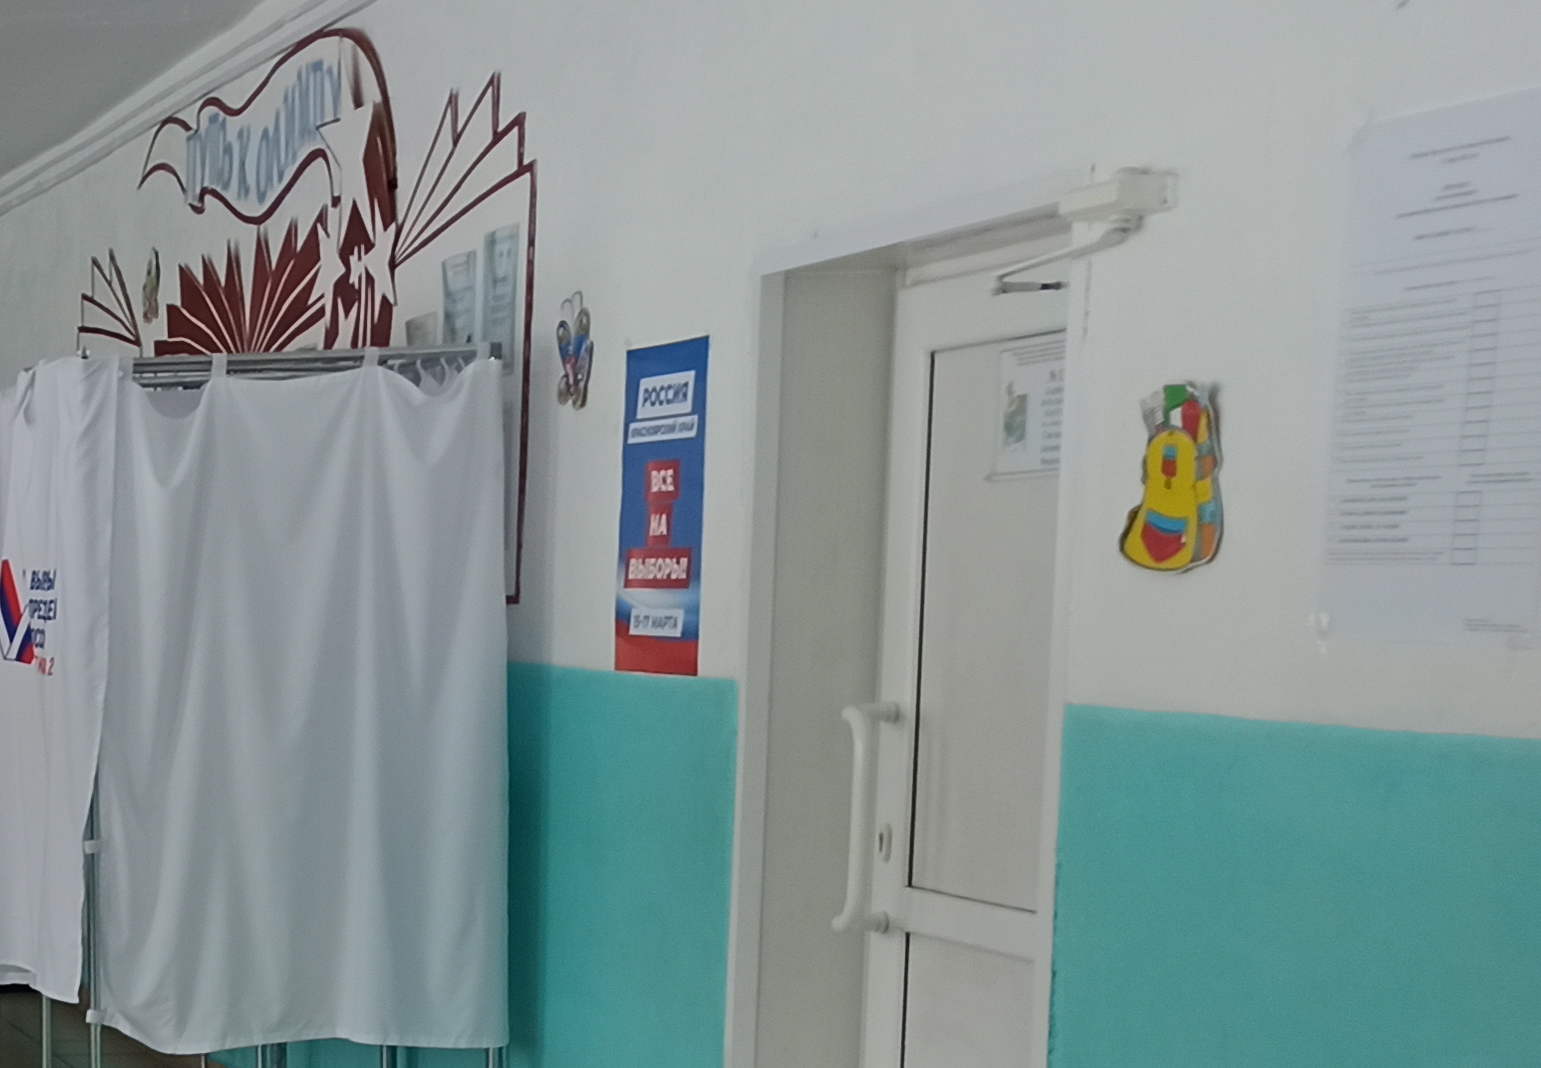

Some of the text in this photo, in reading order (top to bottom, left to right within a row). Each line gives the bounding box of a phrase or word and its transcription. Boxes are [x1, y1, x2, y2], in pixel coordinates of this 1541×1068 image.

[640, 381, 690, 408] РОССИЯ
[650, 468, 675, 493] ВСЕ
[649, 513, 668, 537] НА
